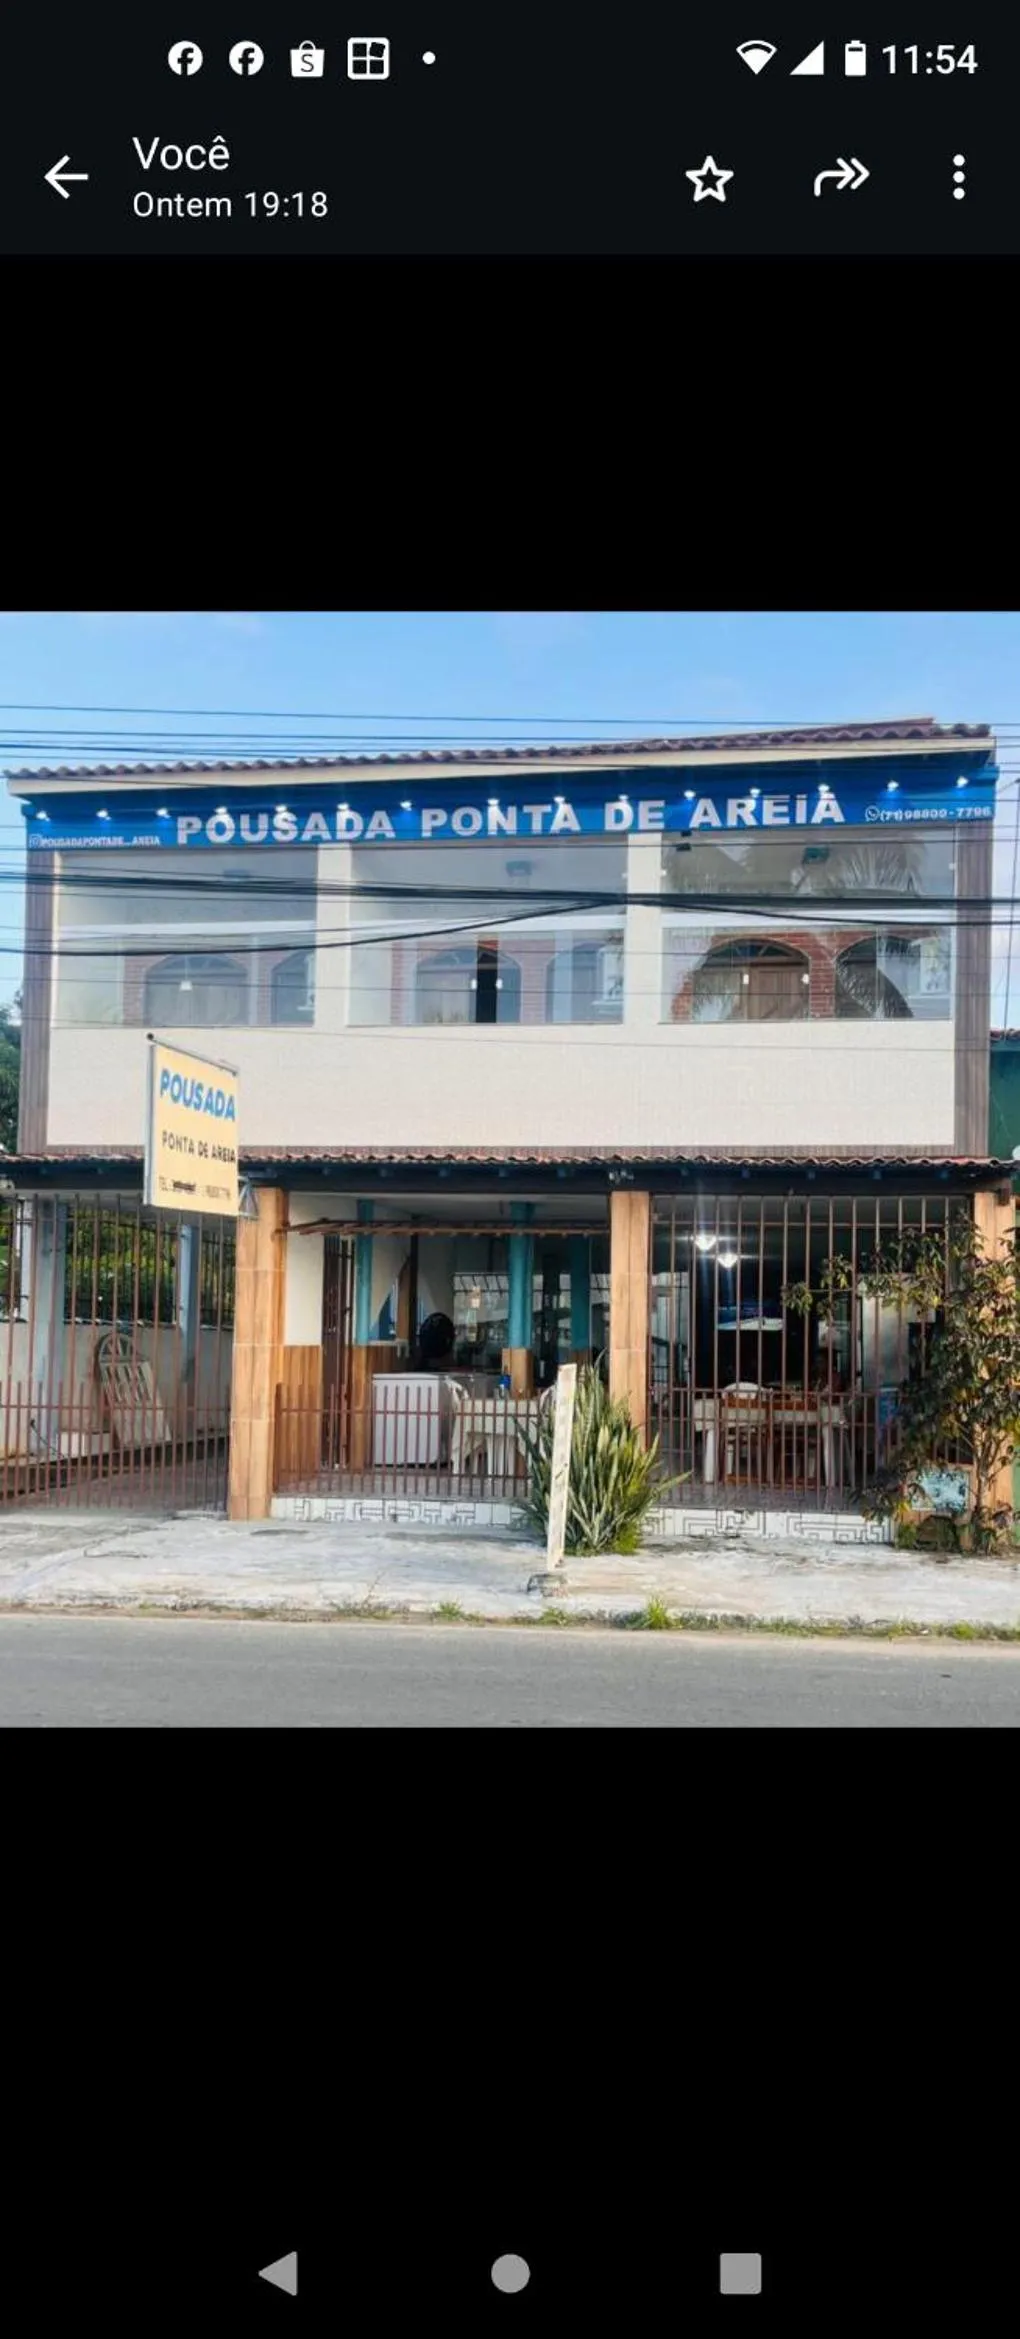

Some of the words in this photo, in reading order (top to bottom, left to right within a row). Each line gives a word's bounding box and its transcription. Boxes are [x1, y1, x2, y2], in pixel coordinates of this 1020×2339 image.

[176, 810, 396, 845] POUSADA
[421, 804, 582, 835] PONTA
[604, 800, 665, 831] DE
[689, 793, 845, 828] AREIA
[160, 1068, 236, 1121] POUSADA
[162, 1129, 195, 1154] PONTA
[197, 1140, 209, 1159] DE
[211, 1145, 236, 1164] AREIA
